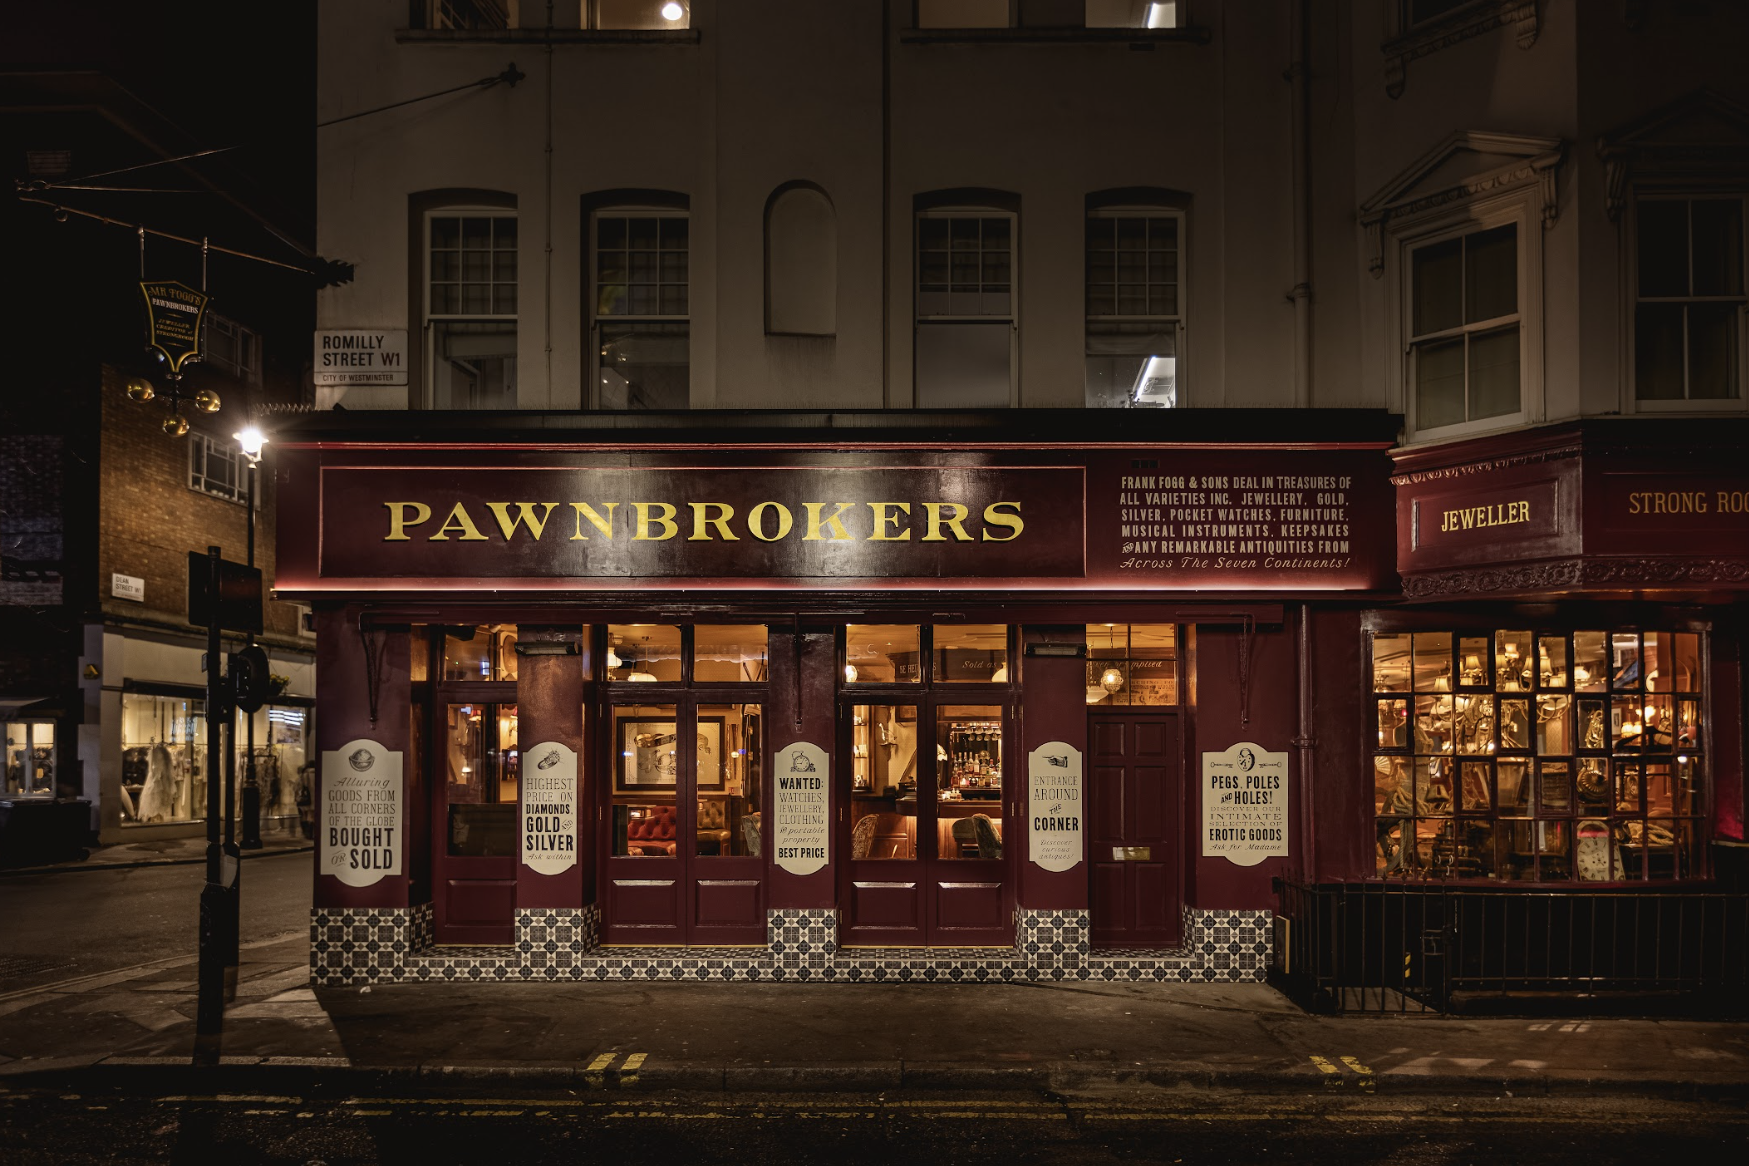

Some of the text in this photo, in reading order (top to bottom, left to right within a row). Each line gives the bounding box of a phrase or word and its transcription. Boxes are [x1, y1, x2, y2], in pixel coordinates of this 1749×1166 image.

[148, 286, 201, 305] MR FOGG'S
[152, 297, 199, 314] PAWNBROKERS
[323, 335, 384, 349] ROMILLY
[323, 352, 400, 366] STREET W1
[1122, 476, 1351, 489] FRANK FOGG & SONS DEAL IN TREASURES OF
[1120, 492, 1348, 506] ALL VARIETIES INC. JEWELLERY, GOLD,
[1629, 492, 1707, 514] STRONG
[381, 500, 1025, 543] PAWNBROKERS
[1122, 509, 1348, 522] SILVER, POCKET WATCHES, FURNITURE,
[1441, 501, 1530, 532] JEWELLER
[1122, 525, 1349, 538] MUSICAL INSTRUMENTS, KEEPSAKES
[1135, 541, 1157, 553] ANY
[1162, 541, 1235, 553] REMARKABLE
[1240, 541, 1314, 555] ANTIQUITIES
[1319, 541, 1349, 553] FROM
[1120, 557, 1350, 568] Across The Seven Continents!
[115, 576, 129, 584] DEAN
[115, 583, 133, 592] STREET
[962, 660, 983, 668] Sold
[334, 777, 390, 789] Alluring
[526, 778, 573, 790] HIGHEST
[779, 777, 824, 789] WANTED:
[1034, 776, 1078, 785] ENTRANCE
[1246, 775, 1280, 789] POLES
[329, 790, 395, 801] GOODS FROM
[526, 792, 573, 802] PRICE ON
[779, 792, 824, 803] WATCHES,
[1034, 788, 1078, 800] AROUND
[1221, 790, 1272, 804] AND HOLES!
[329, 803, 395, 814] ALL CORNERS
[779, 805, 824, 814] JEWELLERY,
[1049, 803, 1062, 814] THE
[329, 816, 395, 826] OF THE GLOBE
[526, 816, 560, 832] GOLD
[779, 814, 823, 824] CLOTHING
[1034, 817, 1078, 831] CORNER
[330, 827, 394, 847] BOUGHT
[788, 827, 825, 835] portable
[1209, 828, 1282, 841] EROTIC GOODS
[526, 834, 573, 851] SILVER
[1226, 843, 1241, 851] for
[350, 848, 392, 869] SOLD
[779, 847, 824, 858] BEST PRICE
